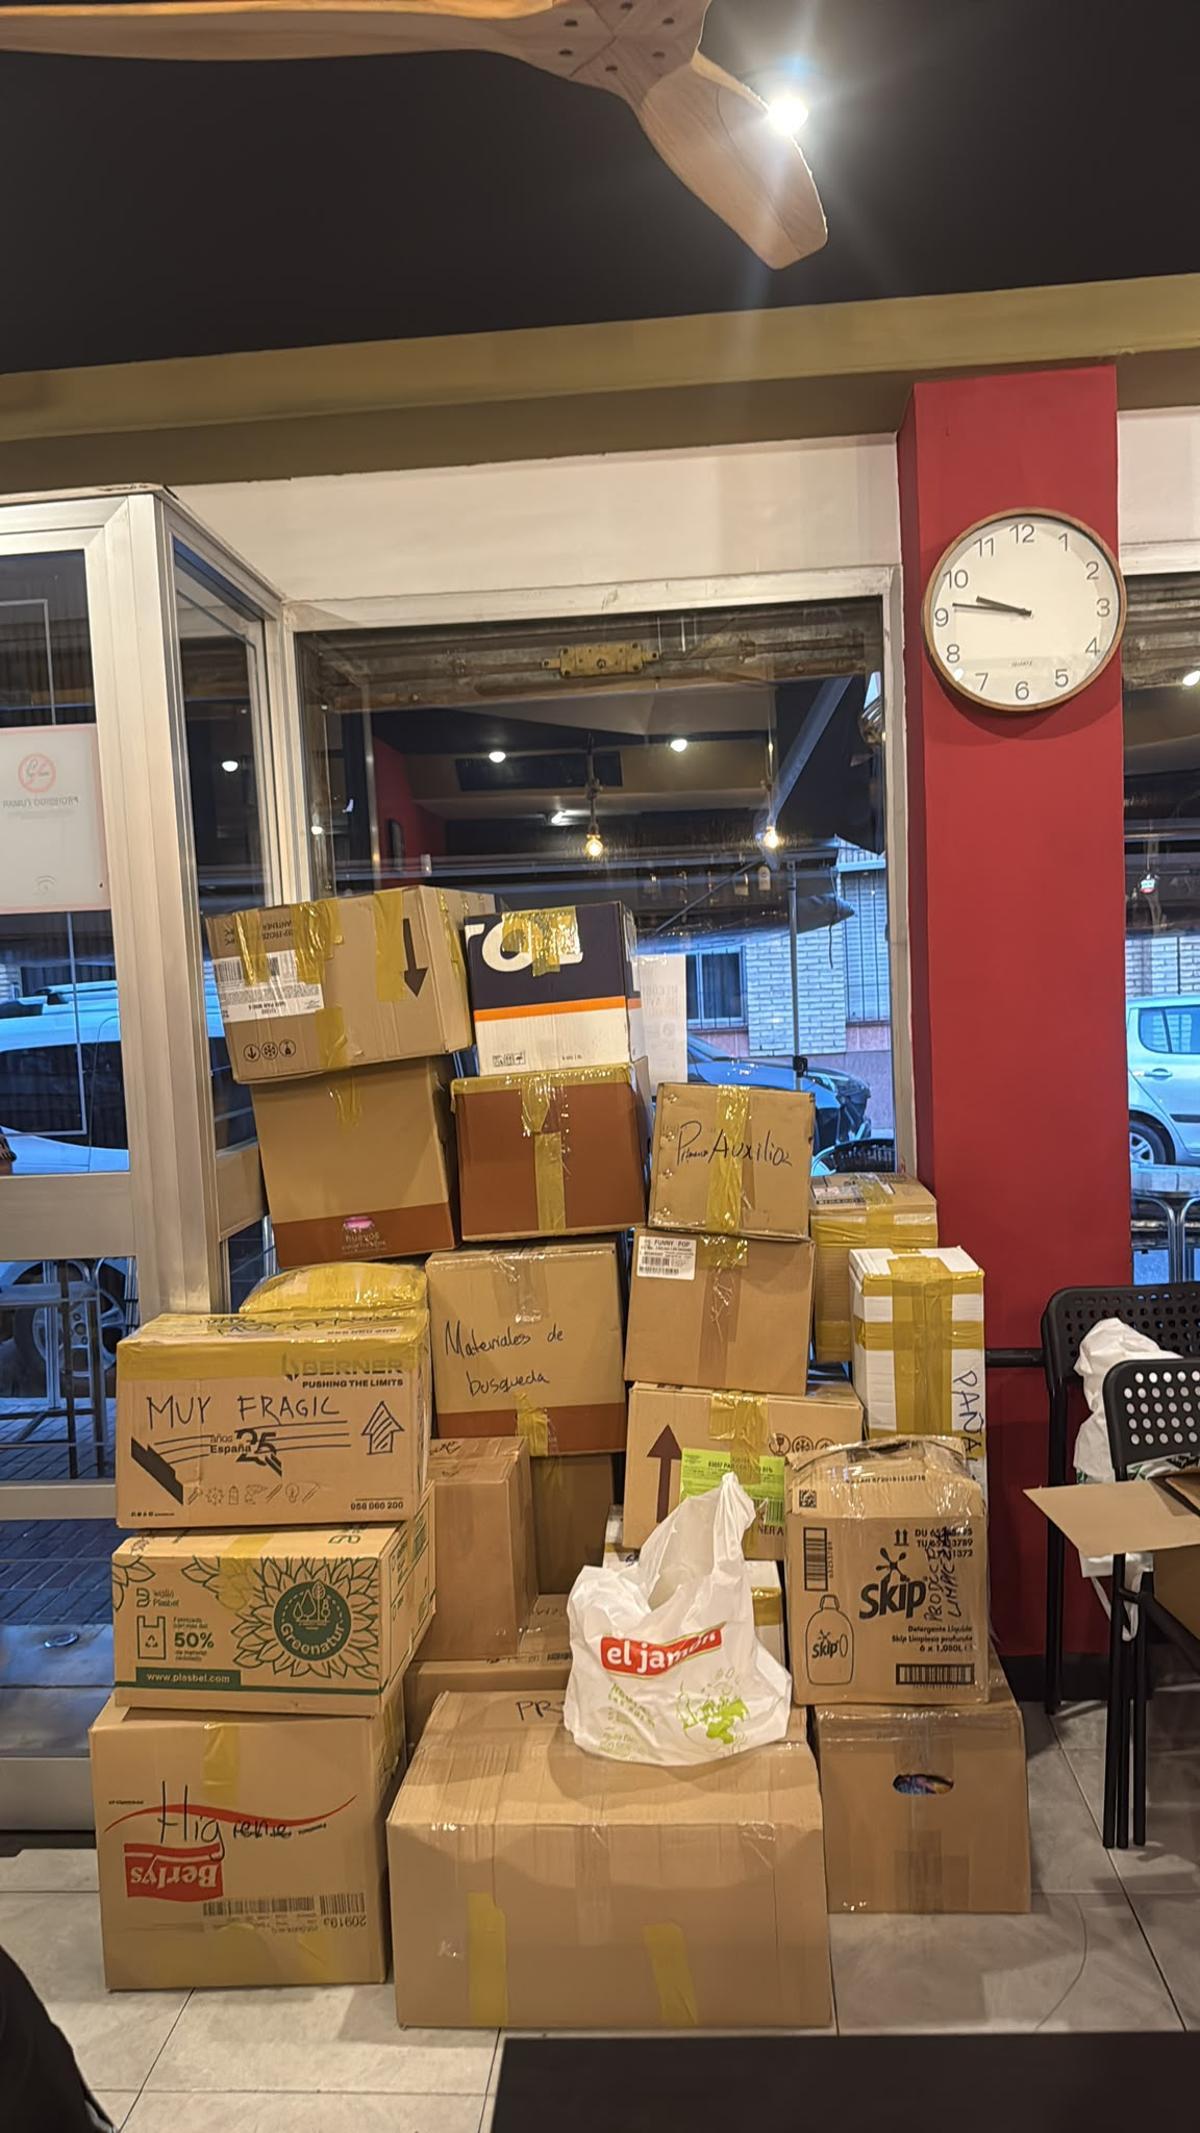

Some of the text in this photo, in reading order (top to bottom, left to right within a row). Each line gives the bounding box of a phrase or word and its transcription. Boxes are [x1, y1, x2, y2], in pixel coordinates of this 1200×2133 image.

[1009, 523, 1035, 544] 12
[1058, 533, 1069, 551] 1
[973, 537, 995, 557] 11
[942, 569, 969, 589] 10
[1085, 561, 1100, 580] 2
[934, 607, 949, 627] 9
[1096, 598, 1110, 617] 3
[946, 643, 960, 664] 8
[1085, 637, 1101, 657] 4
[975, 672, 989, 692] 7
[1055, 669, 1069, 688] 5
[1015, 681, 1030, 700] 6
[445, 1319, 564, 1359] Materiales de
[302, 1358, 403, 1376] BERNER
[302, 1378, 403, 1389] PUSHING THE LIMITS
[466, 1371, 550, 1397] busqueda
[147, 1395, 211, 1430] MUY
[892, 1635, 907, 1643] Skip
[908, 1625, 946, 1634] Detergente
[174, 1632, 214, 1649] 50%
[607, 1640, 632, 1666] el
[147, 1672, 230, 1685] www.plasbel.com
[515, 1700, 563, 1722] PR
[130, 1862, 220, 1890] Berlys
